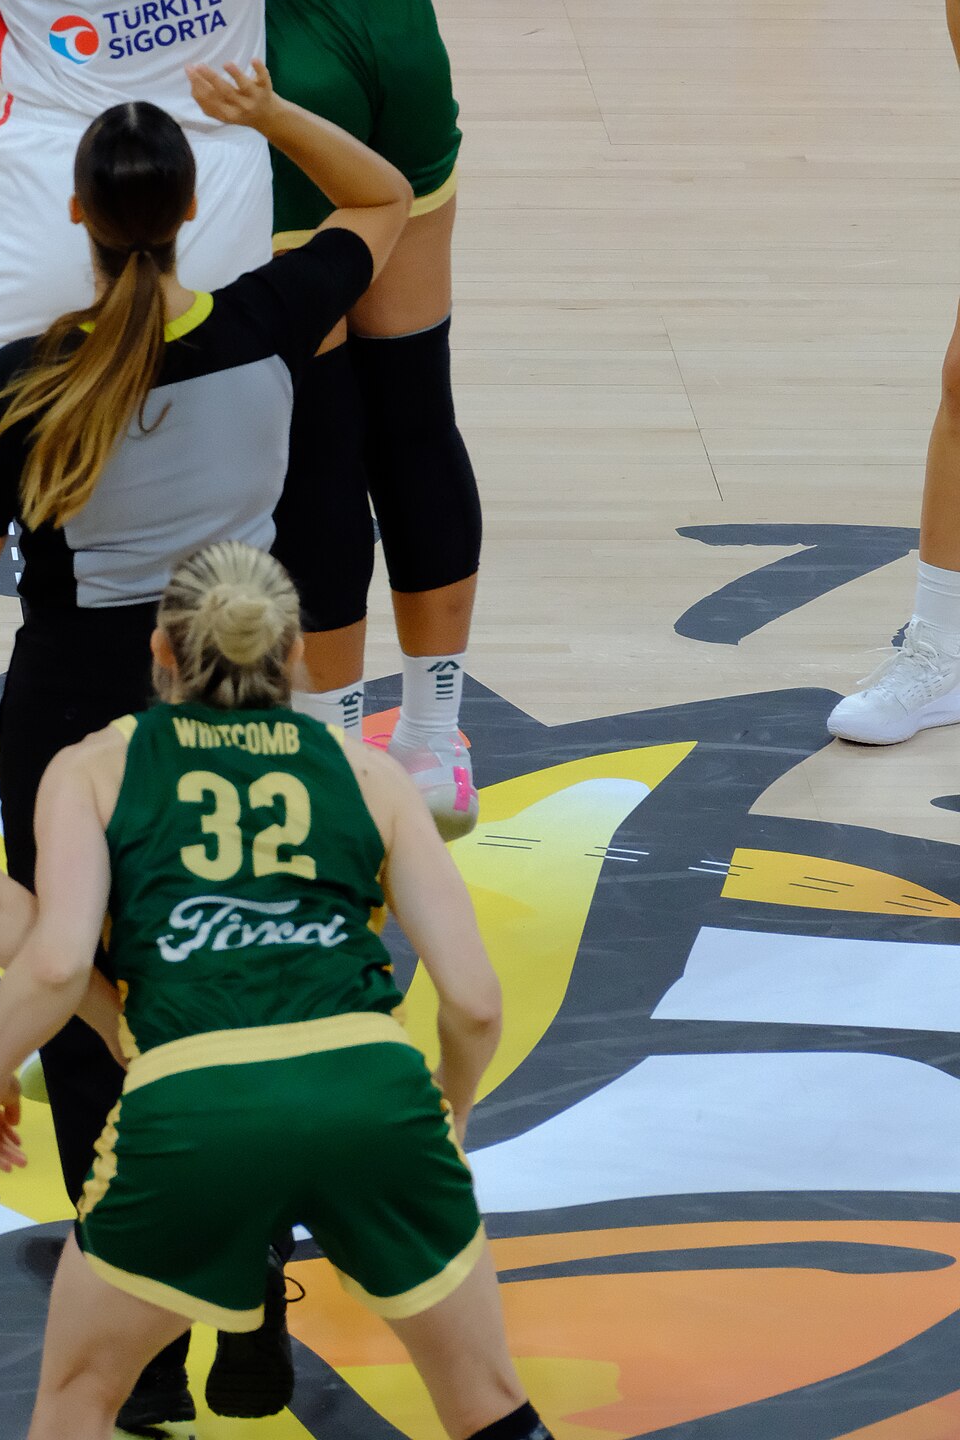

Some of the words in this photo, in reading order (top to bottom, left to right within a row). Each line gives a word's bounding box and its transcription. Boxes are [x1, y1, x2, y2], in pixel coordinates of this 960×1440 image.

[171, 716, 301, 755] WHITCOMB
[177, 769, 317, 882] 32
[156, 894, 349, 963] Ford
